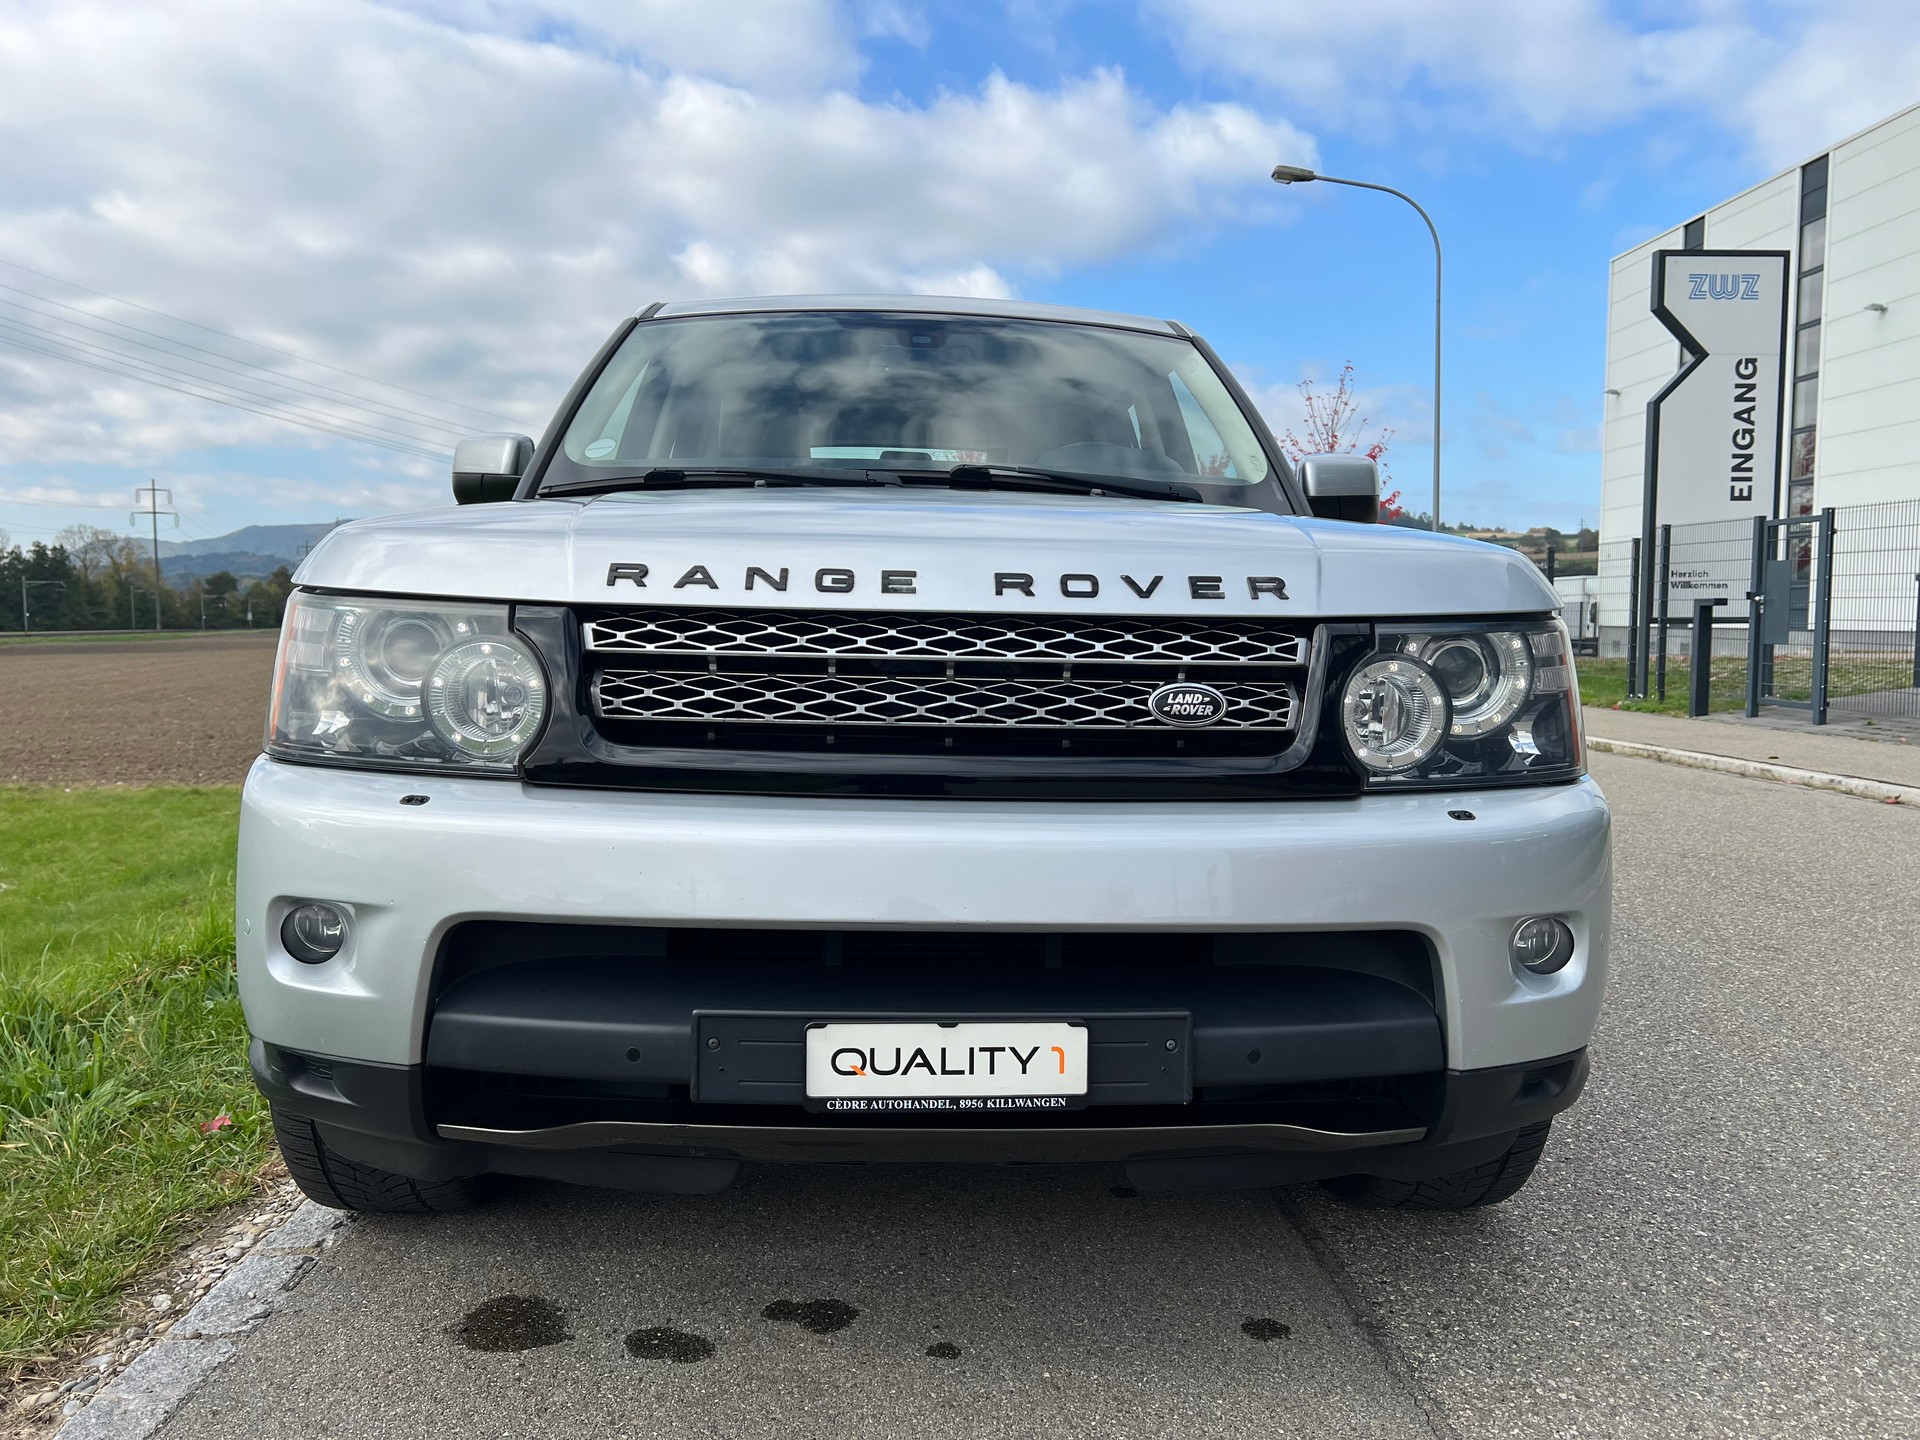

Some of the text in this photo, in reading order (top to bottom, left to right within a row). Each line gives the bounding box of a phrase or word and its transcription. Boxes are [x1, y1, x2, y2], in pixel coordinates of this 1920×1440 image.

[1730, 357, 1759, 503] EINGANG
[1671, 570, 1709, 578] Herzlich
[606, 561, 1290, 600] RANGE ROVER
[1671, 581, 1728, 589] Willkommen
[1167, 693, 1202, 704] LAND
[1170, 704, 1214, 716] ROVER
[830, 1046, 1065, 1076] QUALITY 1
[826, 1097, 1067, 1110] CÈDRE AUTOHANDEL, 8956 KILLWANGEN
